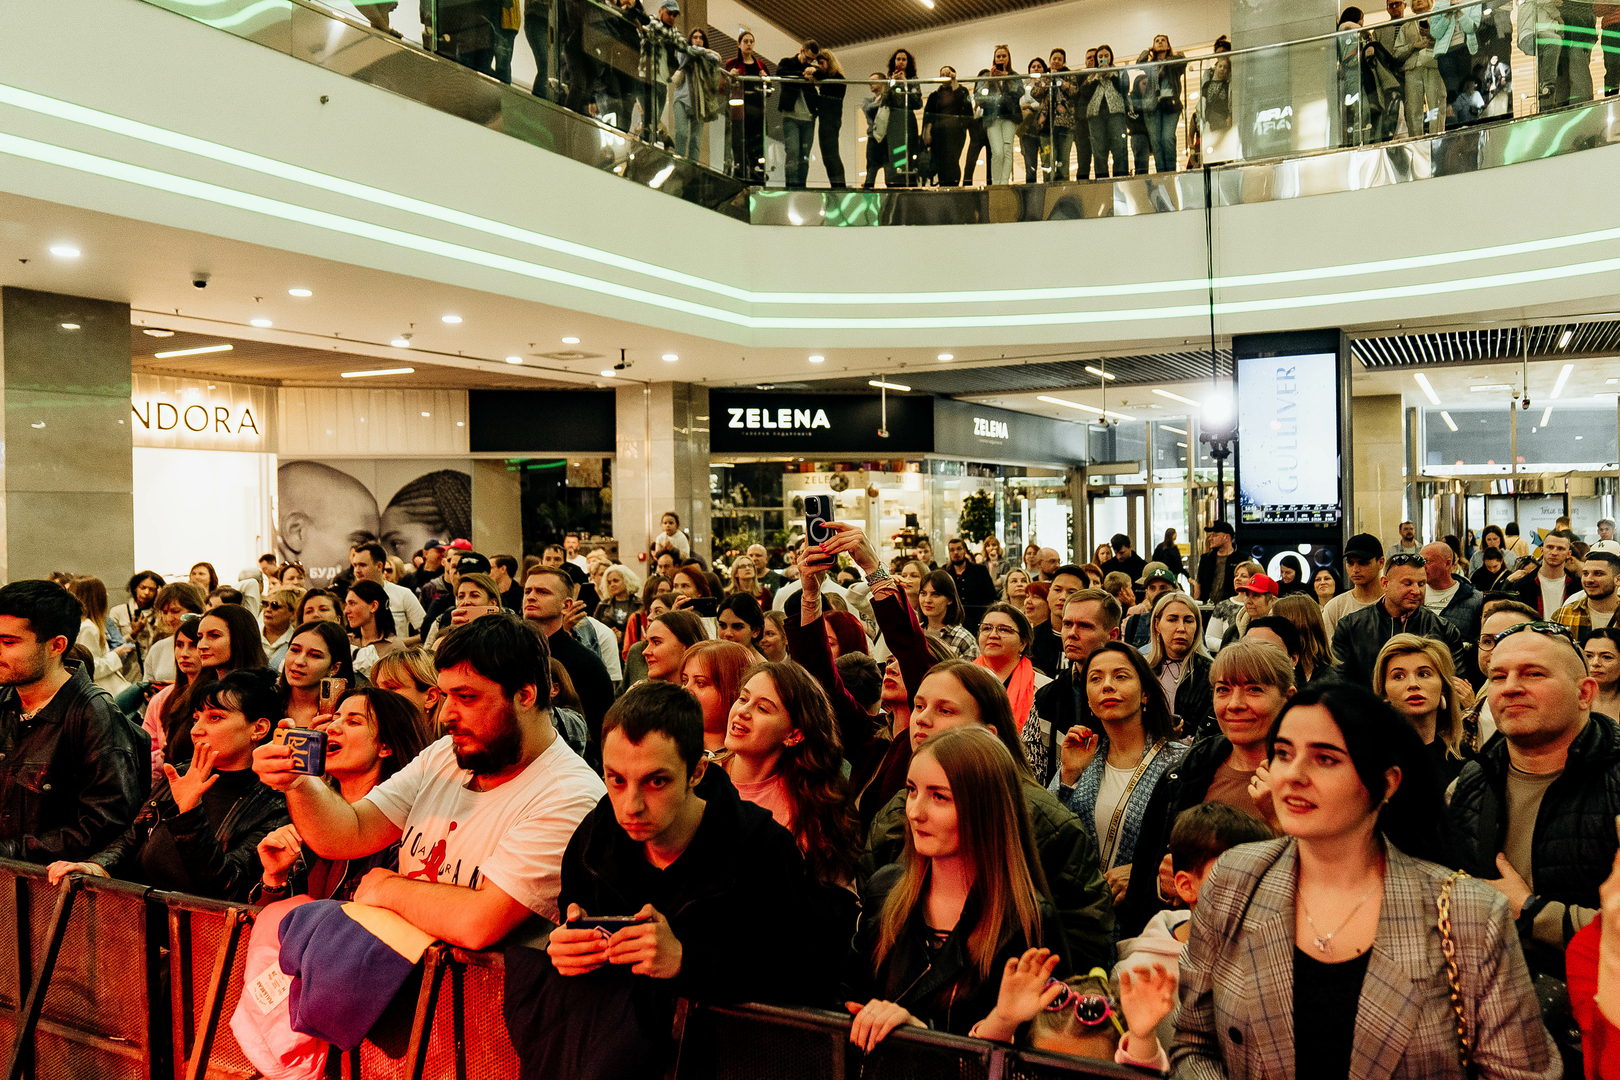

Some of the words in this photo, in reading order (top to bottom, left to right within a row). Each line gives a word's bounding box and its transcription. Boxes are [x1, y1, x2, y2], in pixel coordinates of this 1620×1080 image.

[727, 408, 831, 429] ZELENA
[973, 417, 1009, 440] ZELENA
[1276, 366, 1299, 495] GULLIVER
[399, 825, 482, 891] JOAN
